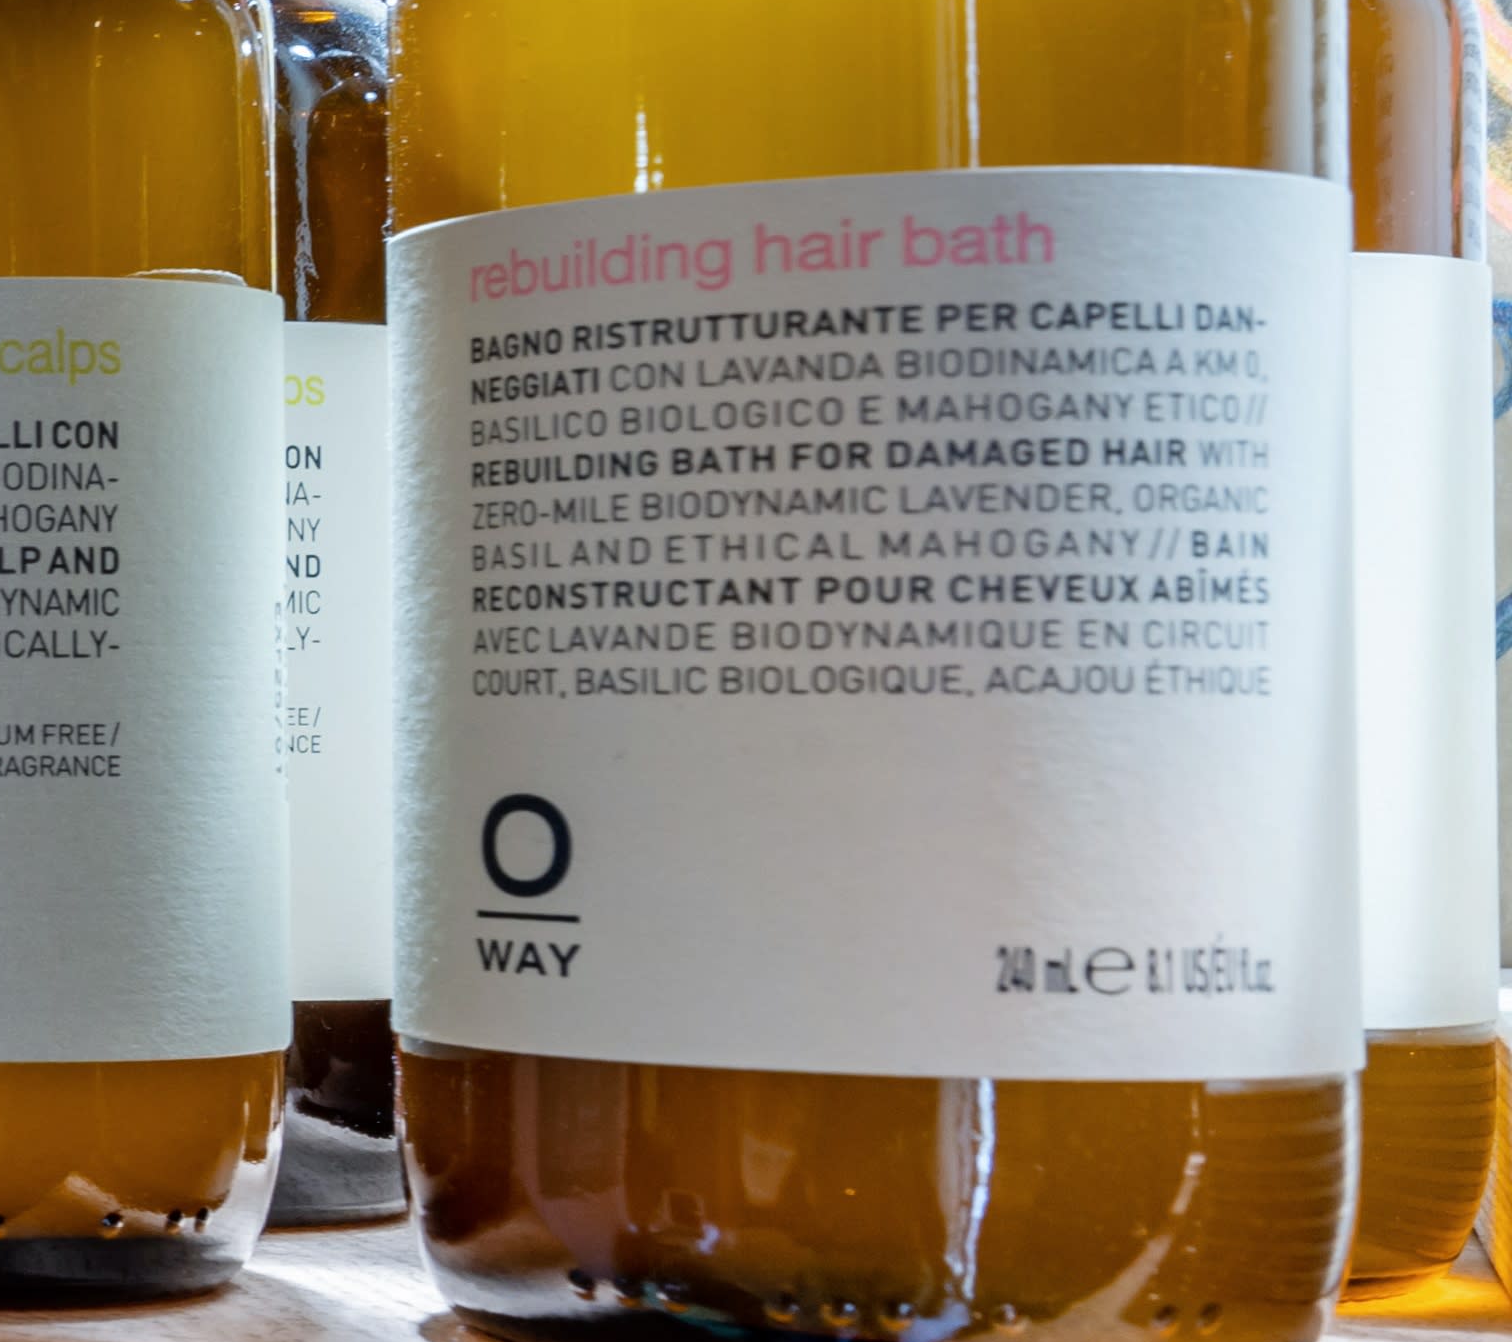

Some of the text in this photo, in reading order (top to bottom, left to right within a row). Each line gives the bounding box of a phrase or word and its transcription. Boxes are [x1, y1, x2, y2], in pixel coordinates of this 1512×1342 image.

[470, 212, 1056, 301] rebuilding hair bath
[470, 330, 563, 365] BAGNO
[571, 306, 924, 353] RISTRUTTURANTE
[935, 304, 1017, 334] PER
[1030, 303, 1184, 332] CAPELLI
[470, 349, 1156, 403] NEGGIATI CON LAVANDA BIODINAMICA
[52, 421, 118, 449] CON
[471, 394, 1134, 446] BASILICO BIOLOGICO E MAHOGANY
[472, 438, 1186, 488] REBUILDING BATH FOR DAMAGED HAIR
[472, 494, 630, 531] ZERO-MILE
[640, 487, 887, 522] BIODYNAMIC
[48, 548, 119, 574] AND
[472, 529, 1268, 572] BASIL AND ETHICAL MAHOGANY BAIN
[472, 578, 801, 613] RECONSTRUCTANT
[817, 576, 935, 606] POUR
[948, 575, 1138, 605] CHEVEUX
[548, 620, 1130, 654] LAVANDE BIODYNAMIQUE EN
[576, 665, 1135, 698] BASILIC ACAJOU
[482, 793, 572, 899] O
[476, 939, 580, 978] WAY
